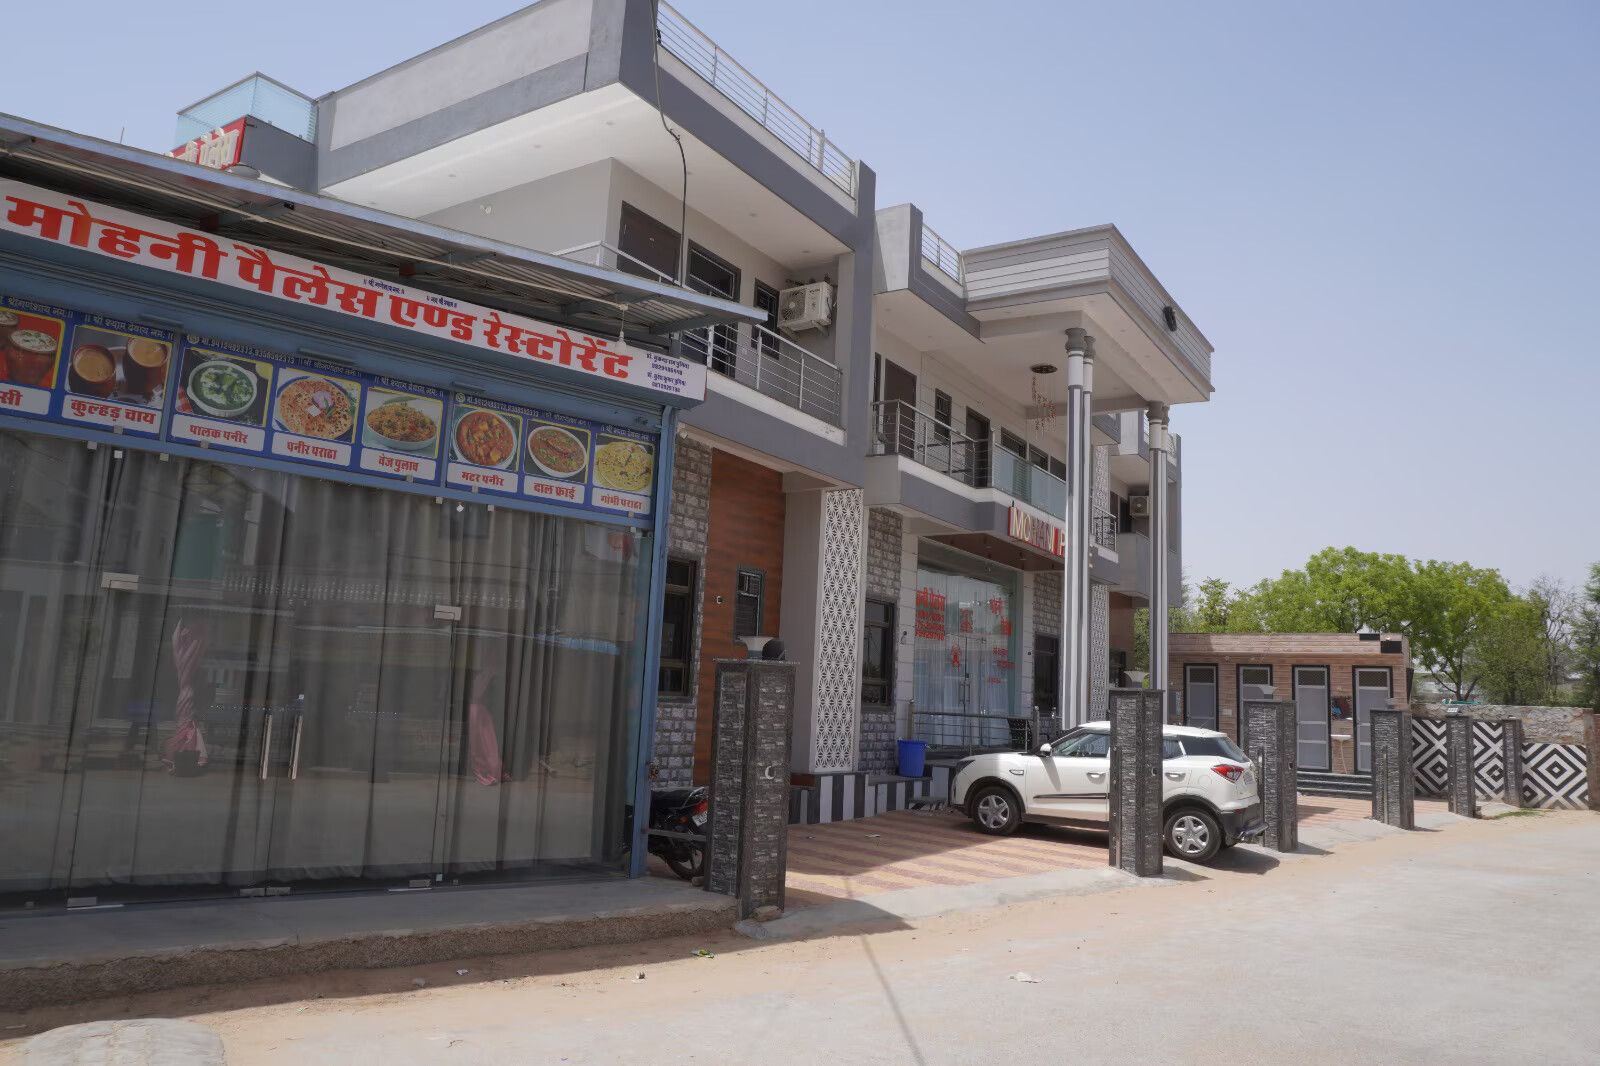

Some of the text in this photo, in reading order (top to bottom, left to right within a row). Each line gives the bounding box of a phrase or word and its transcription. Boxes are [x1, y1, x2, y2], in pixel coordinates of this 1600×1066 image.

[6, 196, 634, 379] मोहनी पैलेस एण्ड रेस्टोरेंट
[0, 388, 23, 406] सी
[124, 408, 157, 426] चाय
[189, 424, 249, 444] पालक पनीर
[286, 440, 312, 456] पनीर
[378, 455, 394, 468] वेज
[461, 470, 504, 487] मटर पनीर
[534, 482, 554, 495] दाल
